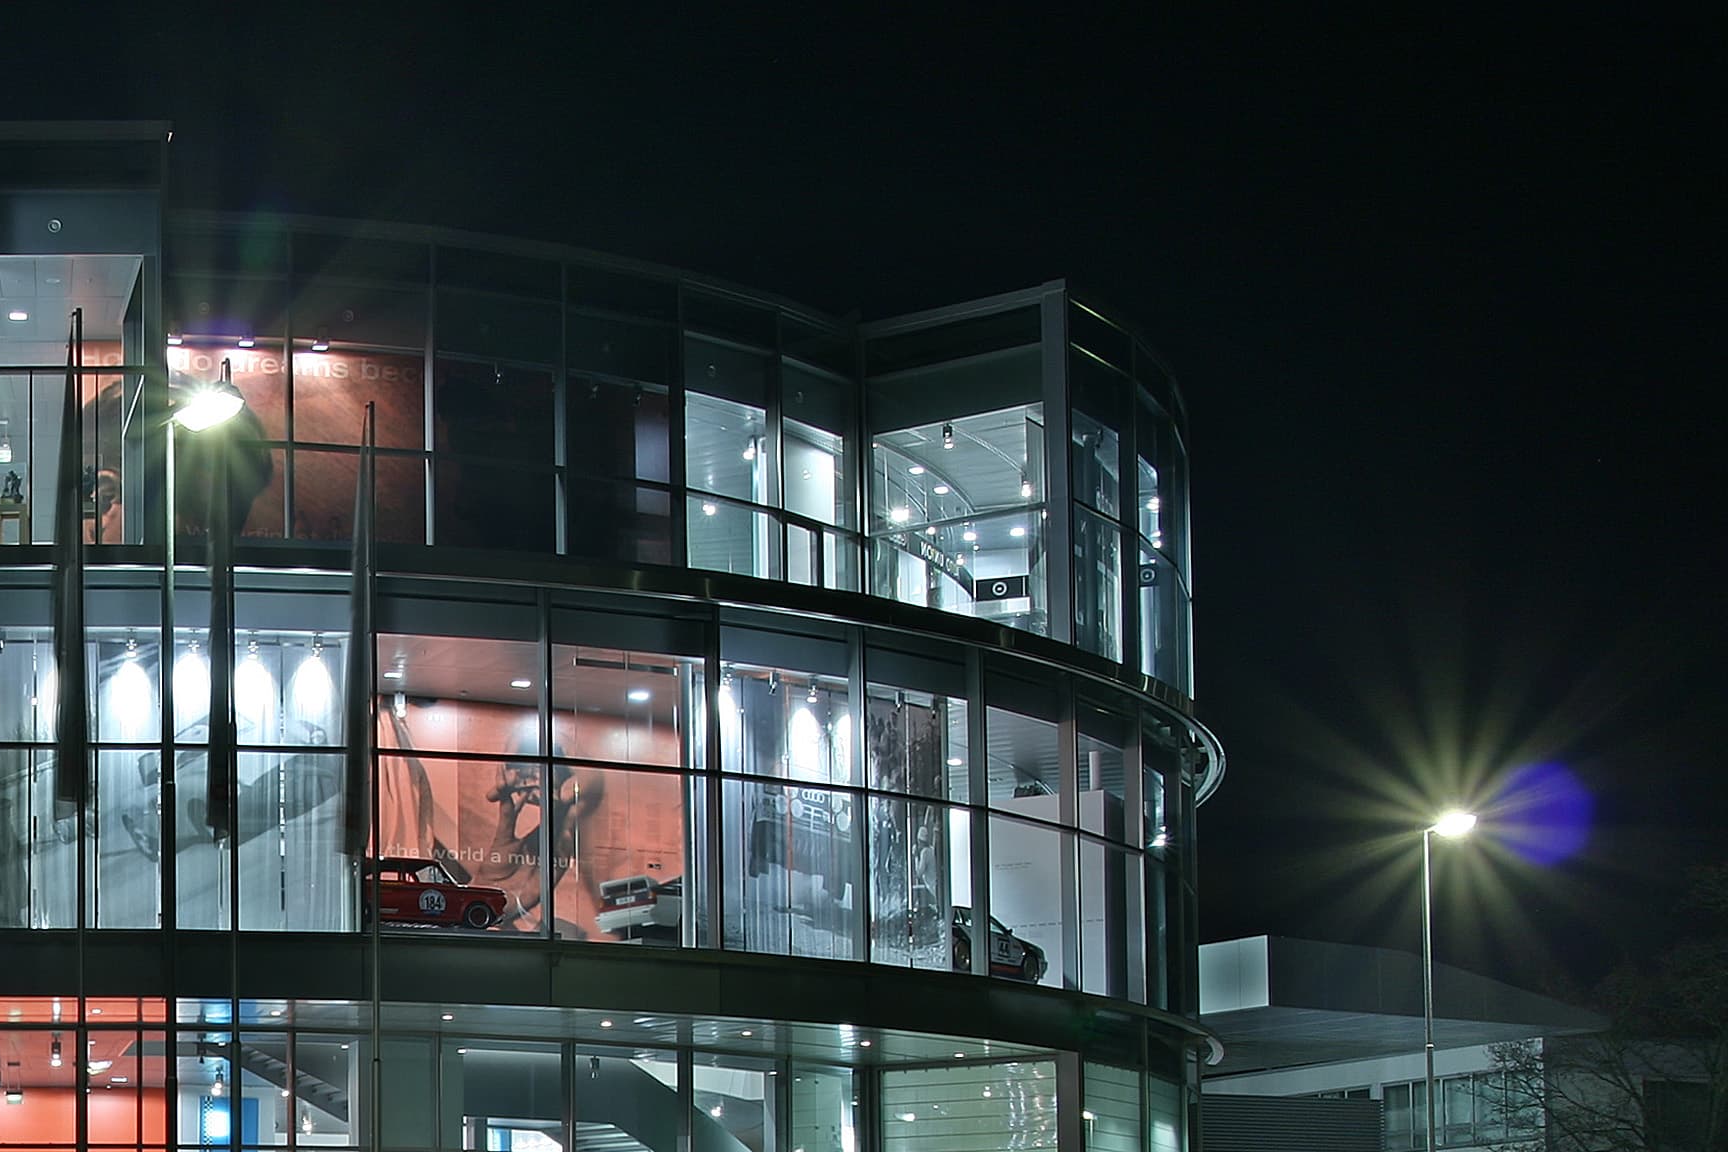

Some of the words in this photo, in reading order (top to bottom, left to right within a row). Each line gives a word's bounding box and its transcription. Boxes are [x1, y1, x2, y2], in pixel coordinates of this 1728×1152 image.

[426, 847, 484, 862] world
[490, 852, 501, 863] a
[508, 853, 576, 868] muu
[424, 895, 441, 910] 184
